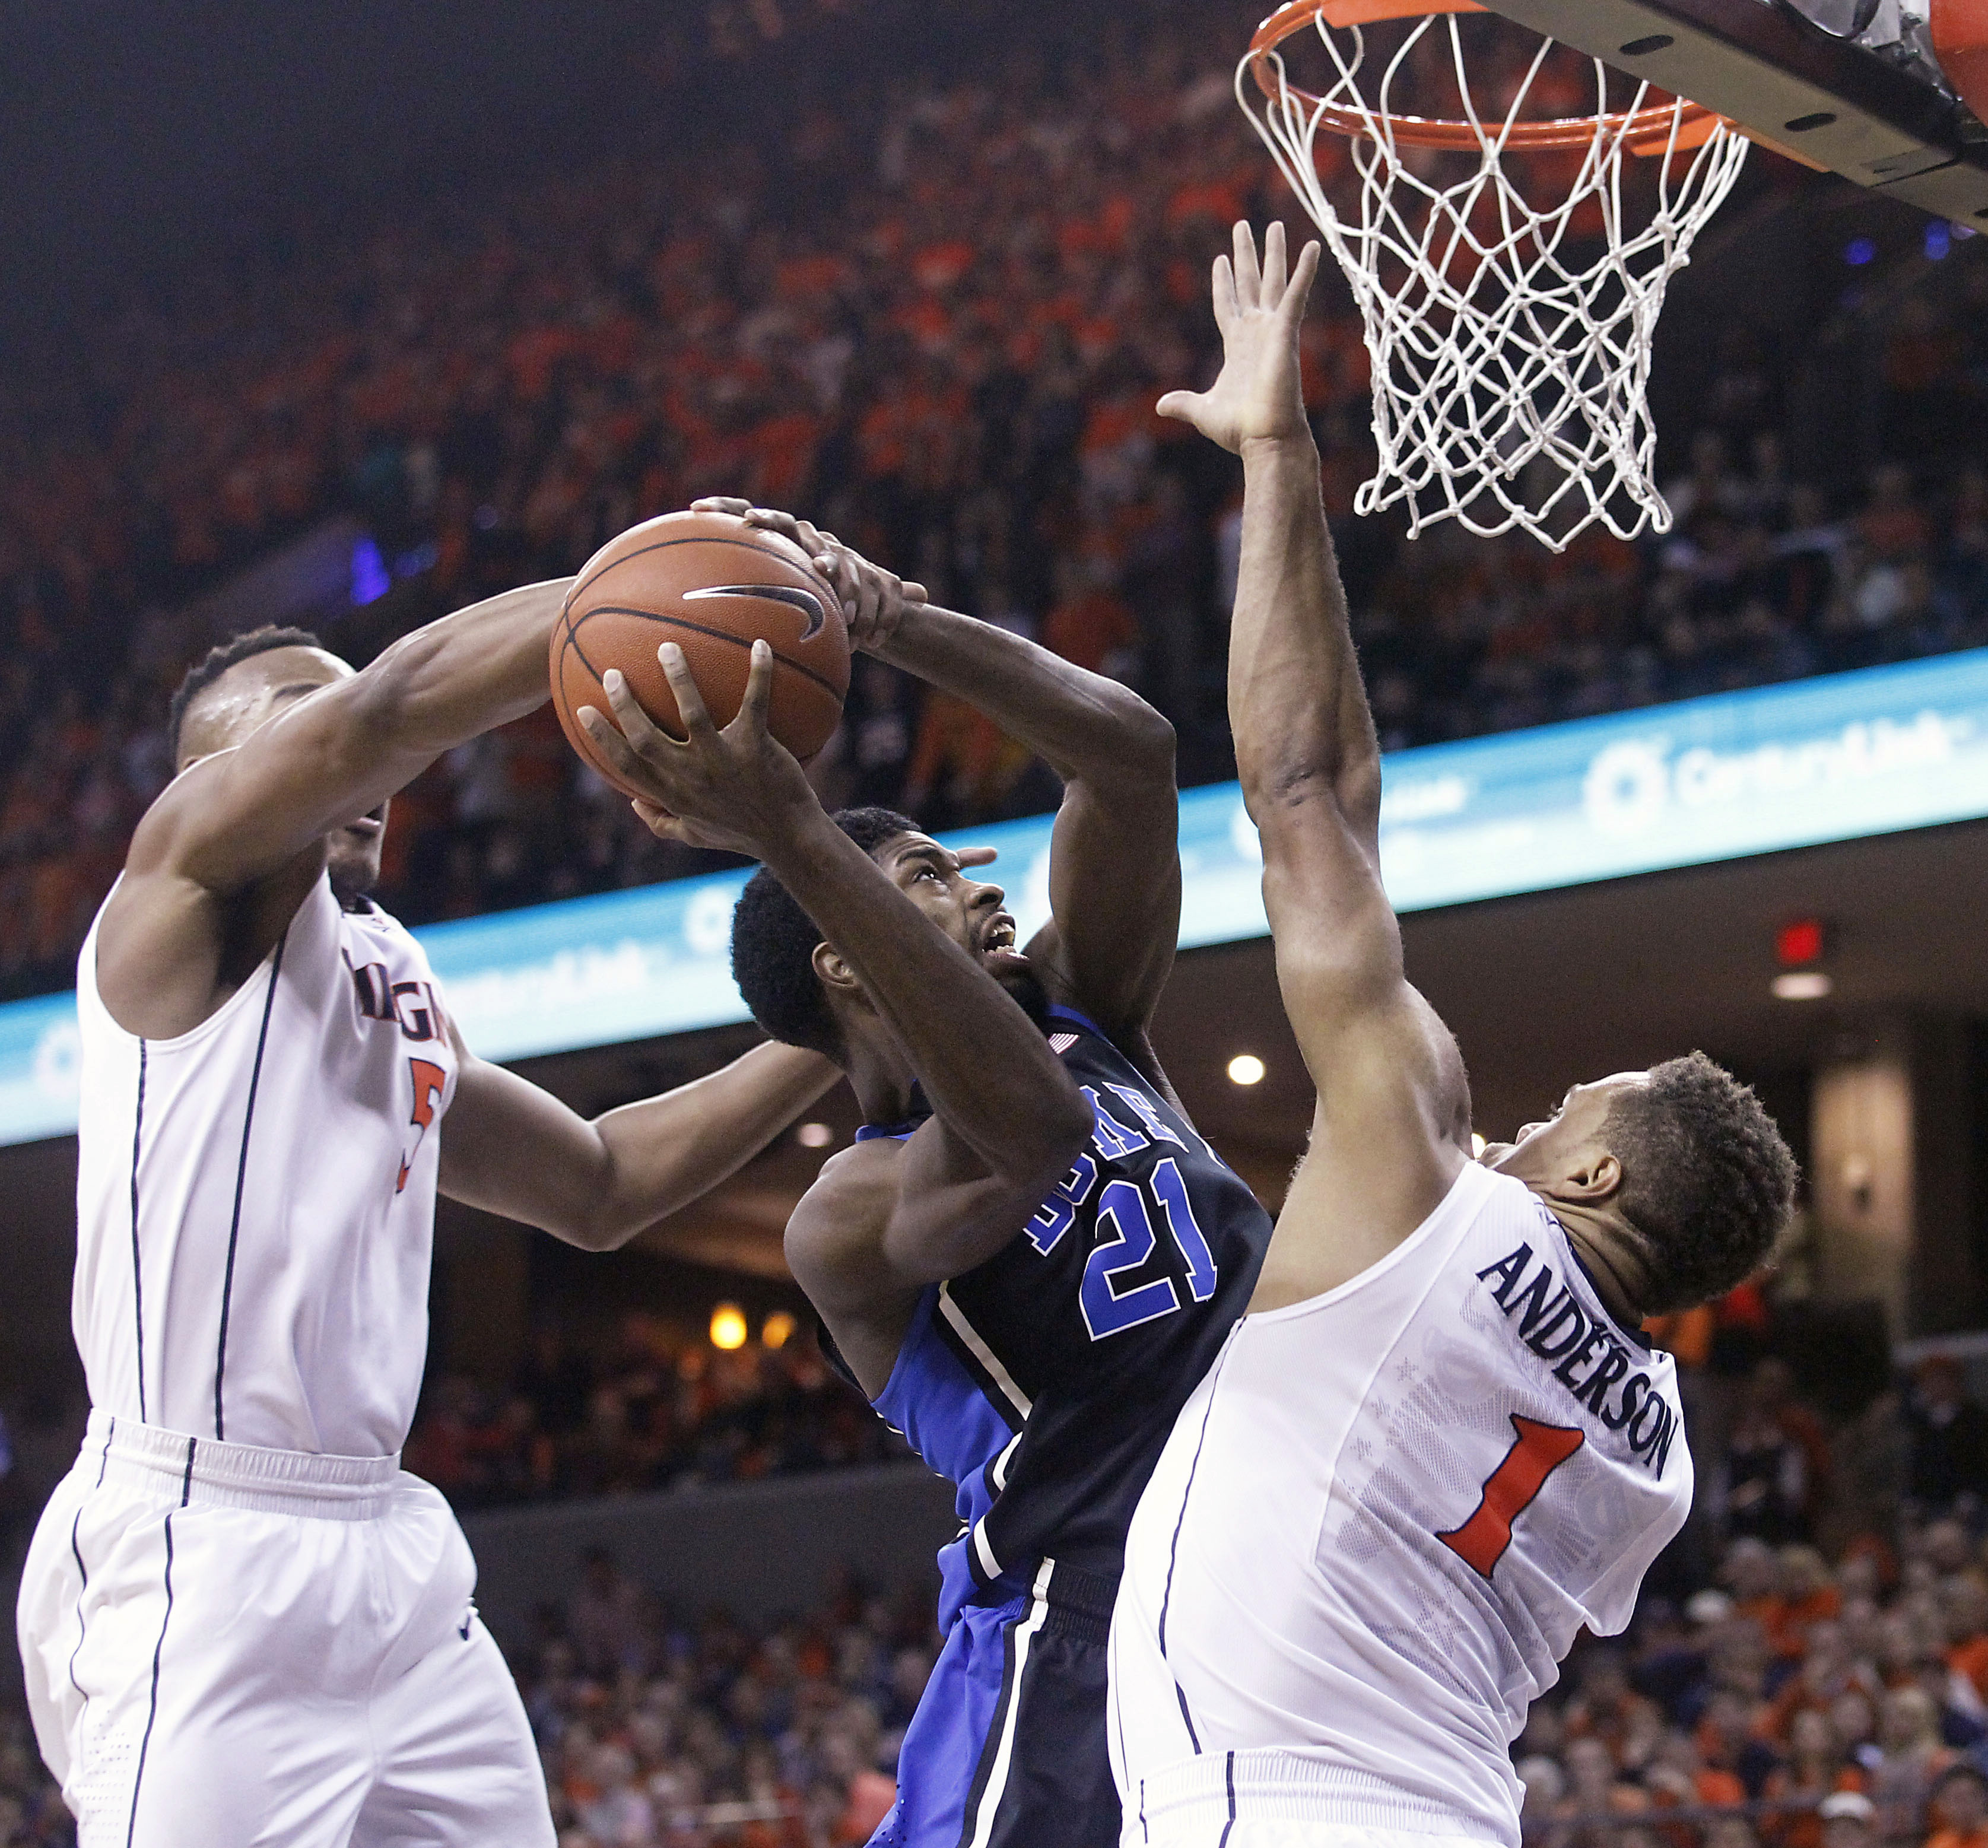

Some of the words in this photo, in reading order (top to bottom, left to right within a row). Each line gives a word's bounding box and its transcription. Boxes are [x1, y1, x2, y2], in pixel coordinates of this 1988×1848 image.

[1078, 1156, 1218, 1342] 21
[1476, 1241, 1679, 1482] ANDERSON
[1434, 1413, 1586, 1580] 1
